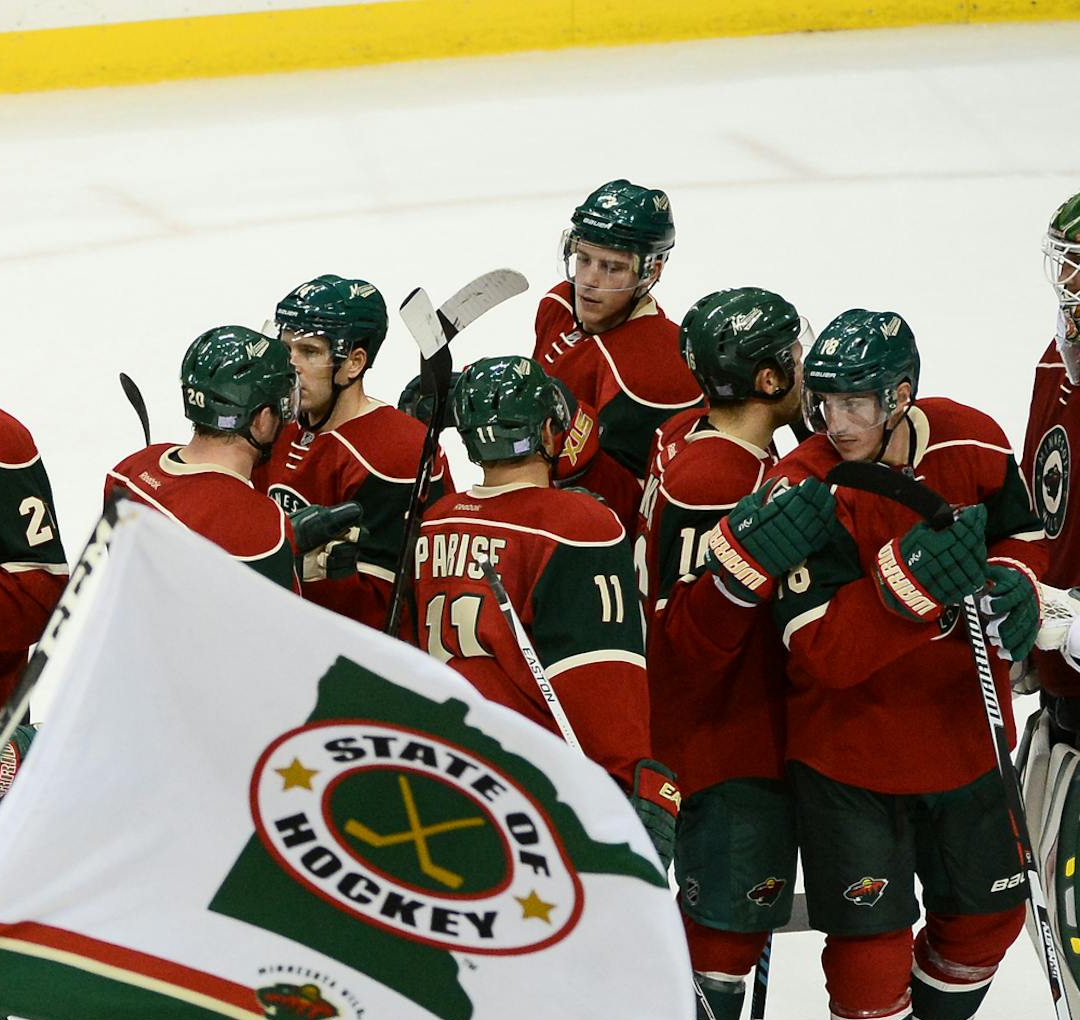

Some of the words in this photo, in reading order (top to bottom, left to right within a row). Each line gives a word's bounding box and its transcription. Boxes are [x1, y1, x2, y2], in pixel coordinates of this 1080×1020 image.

[187, 387, 206, 408] 20
[477, 425, 496, 444] 11
[19, 496, 56, 547] 2
[415, 533, 506, 580] PARISE
[593, 575, 624, 623] 11
[426, 594, 495, 665] 11
[524, 646, 556, 703] EASTON
[324, 735, 507, 802] STATE
[505, 812, 551, 878] OF
[274, 812, 498, 939] HOCKEY
